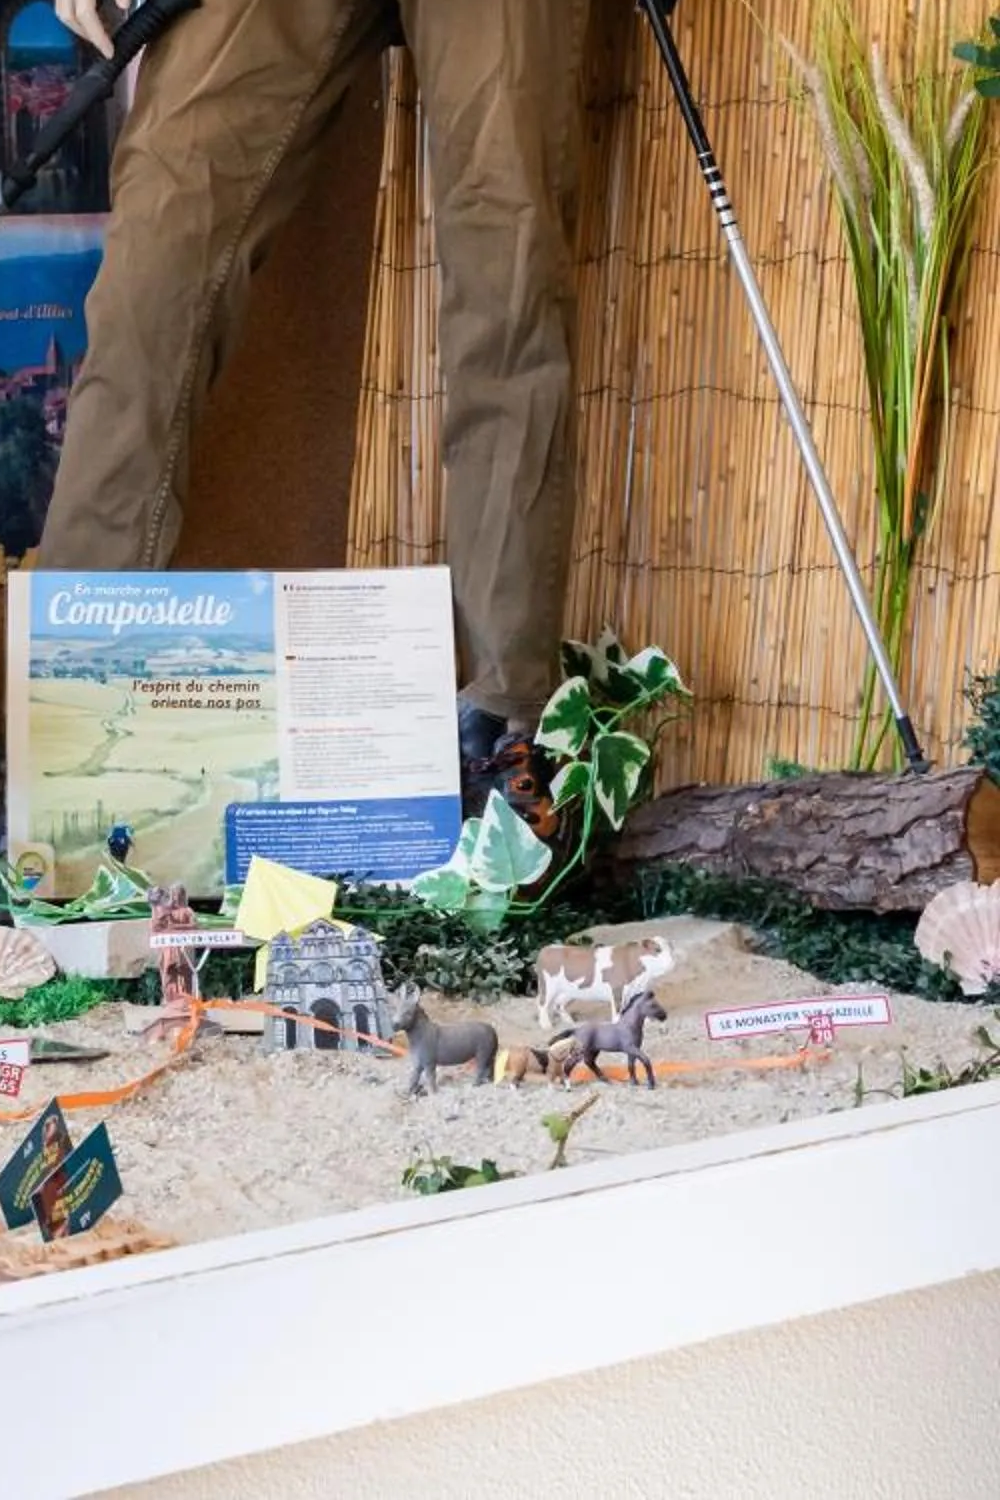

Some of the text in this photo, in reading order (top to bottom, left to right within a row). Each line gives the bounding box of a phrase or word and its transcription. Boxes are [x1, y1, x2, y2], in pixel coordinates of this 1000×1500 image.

[74, 583, 170, 598] En marche vers
[49, 590, 236, 635] Compostelle
[132, 679, 261, 696] l'esprit du chemin
[151, 697, 262, 713] oriente nos pas
[719, 1019, 732, 1030] LE
[735, 1011, 800, 1028] MONASTIER
[1, 1065, 21, 1080] GR
